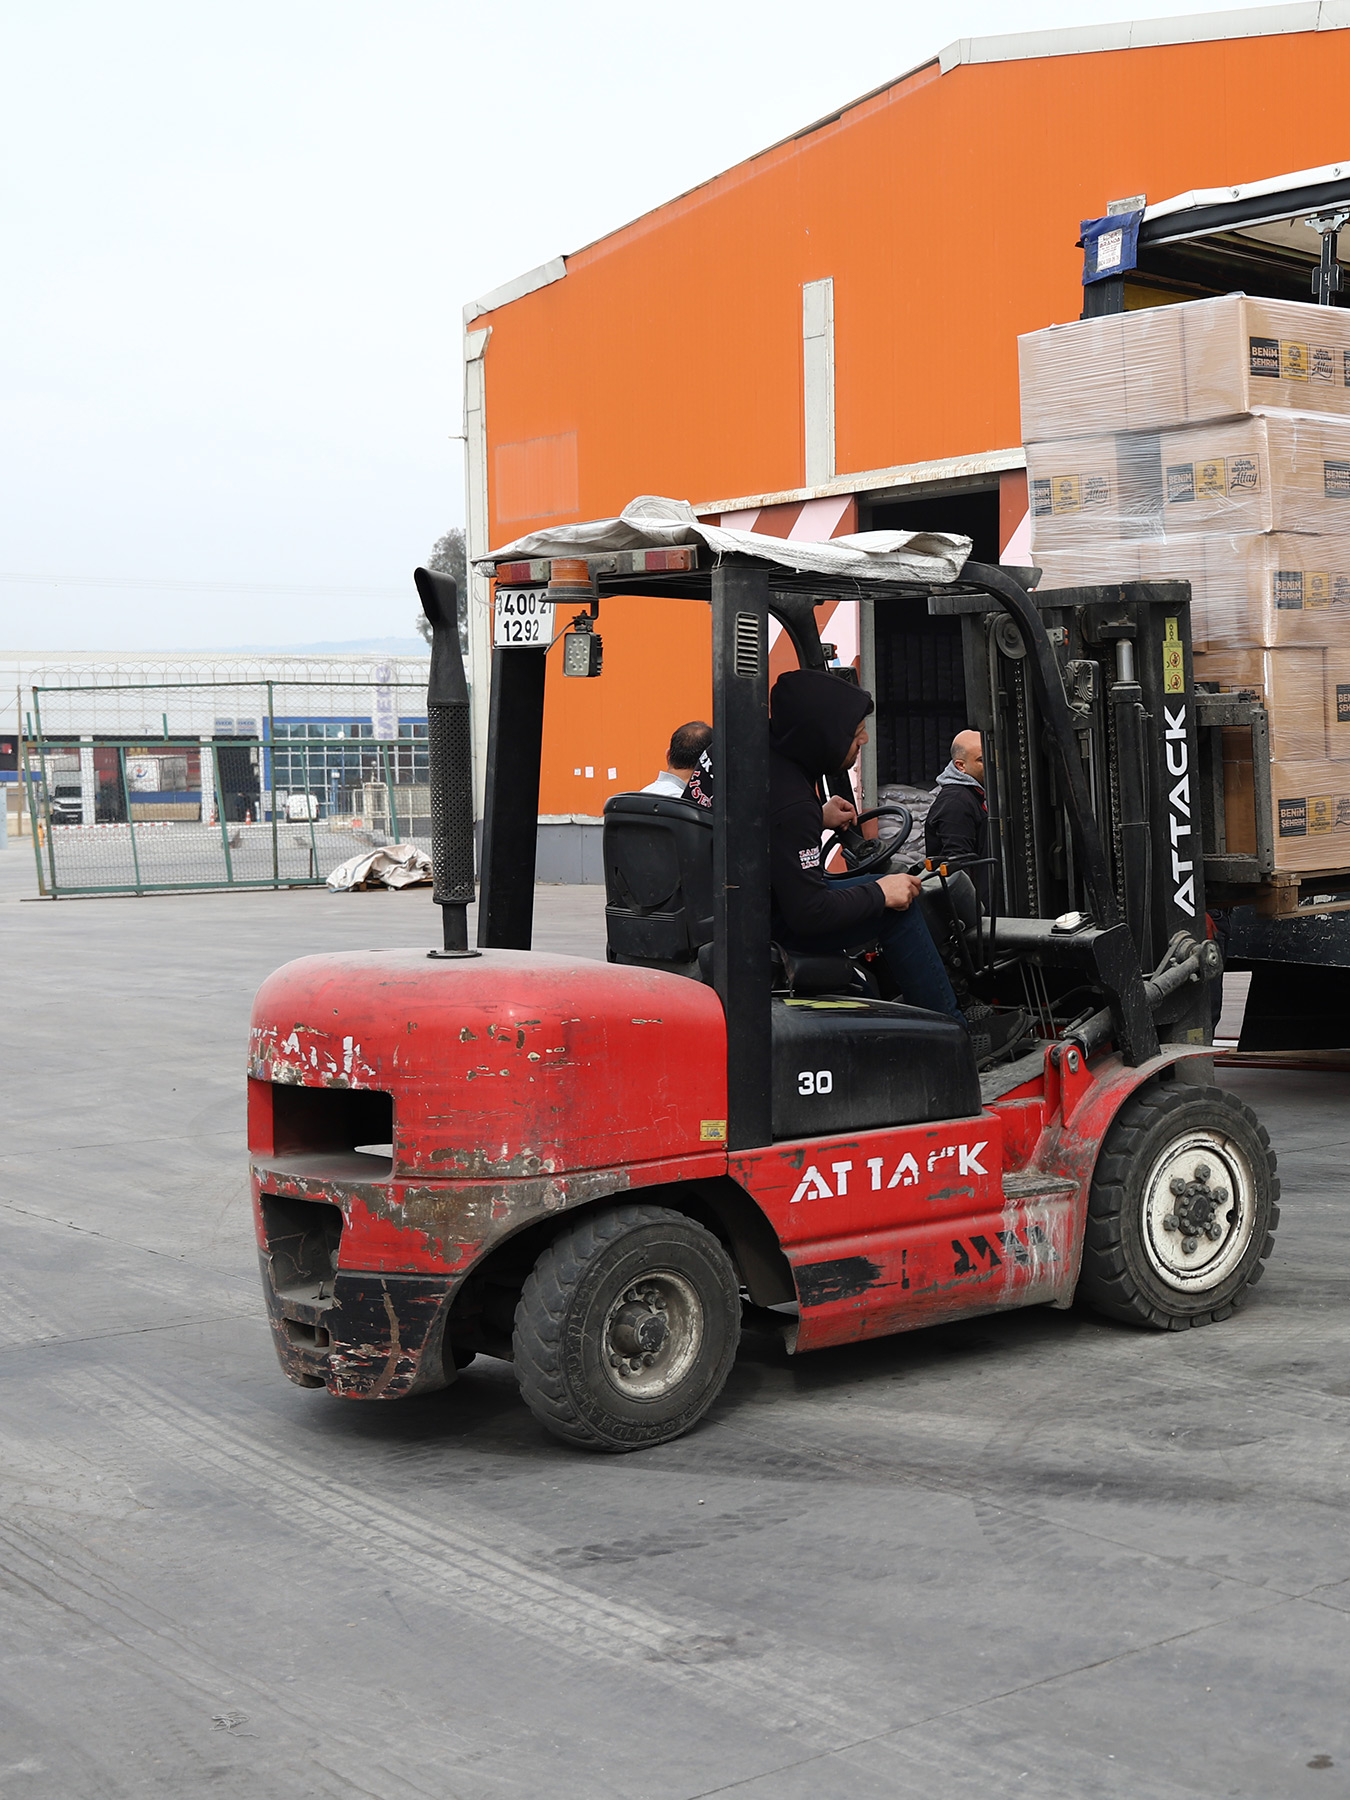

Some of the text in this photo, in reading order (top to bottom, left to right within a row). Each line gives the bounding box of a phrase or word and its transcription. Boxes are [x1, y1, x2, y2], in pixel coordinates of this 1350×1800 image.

[503, 620, 539, 642] 1292
[1163, 704, 1196, 918] ATTACK
[798, 1070, 833, 1095] 30
